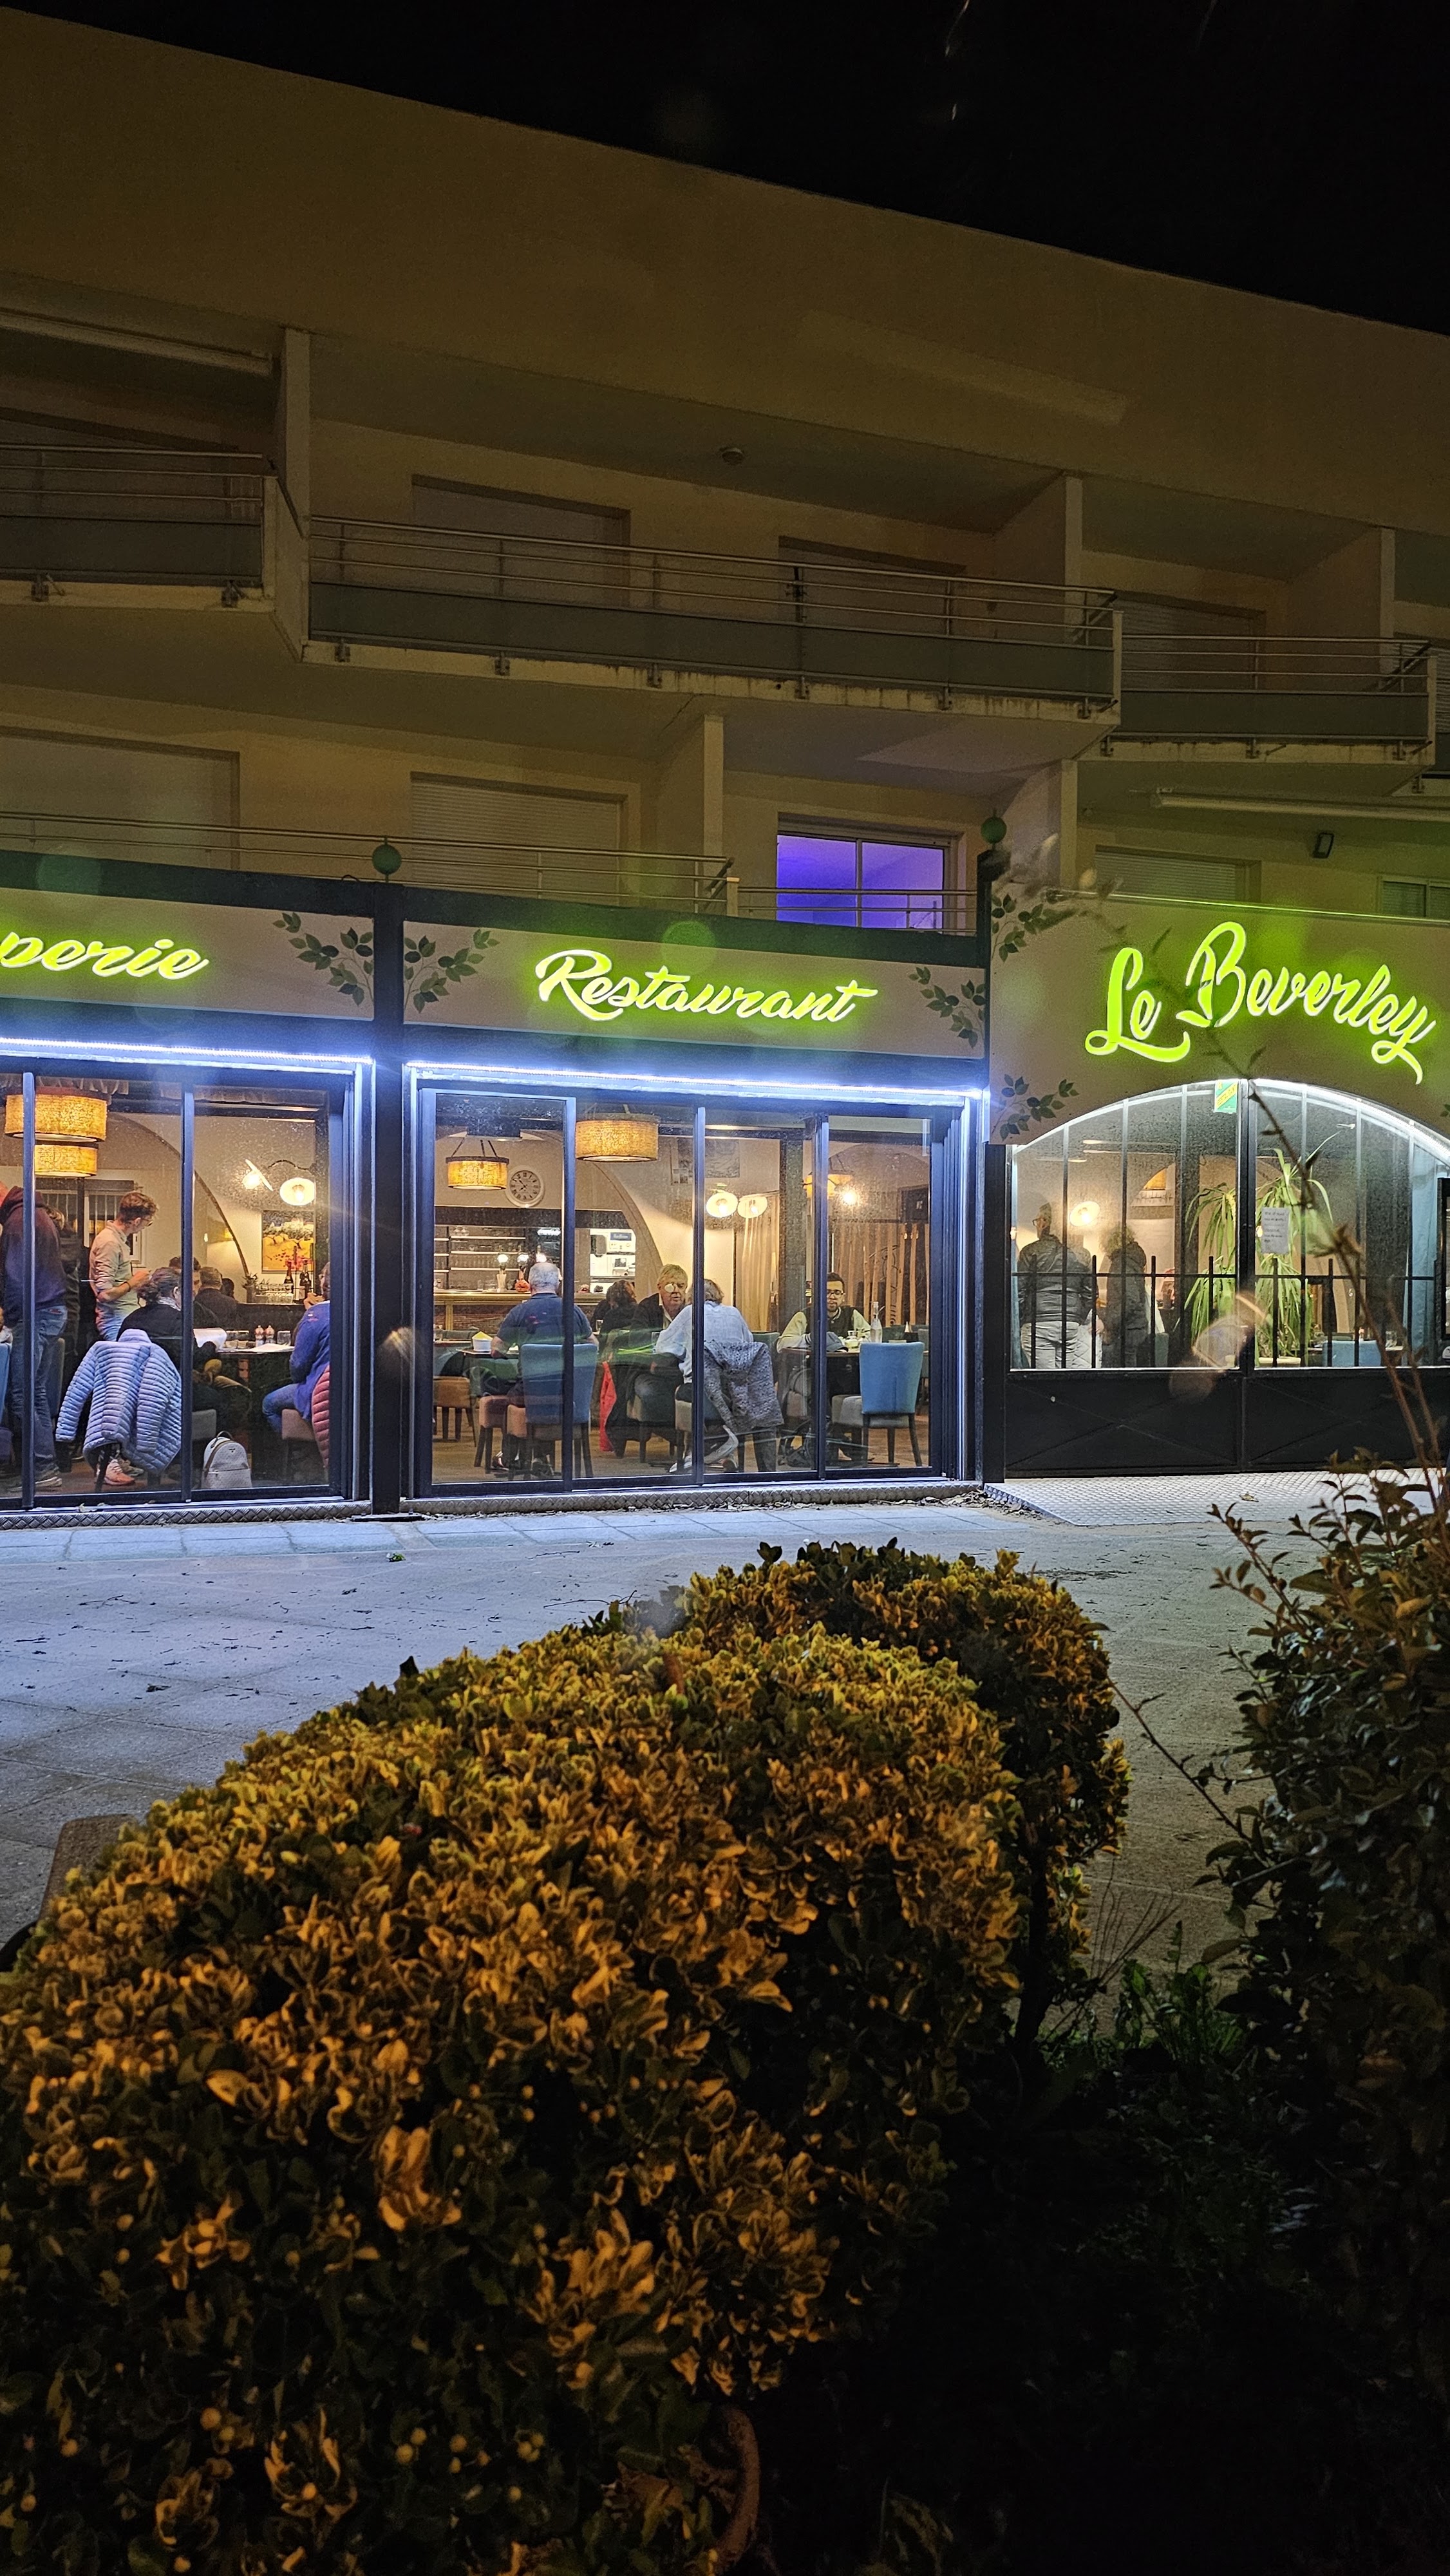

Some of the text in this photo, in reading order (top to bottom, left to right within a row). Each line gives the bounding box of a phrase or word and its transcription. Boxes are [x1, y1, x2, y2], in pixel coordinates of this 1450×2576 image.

[535, 949, 878, 1022] Restaurant
[1086, 922, 1436, 1085] Le Beverley
